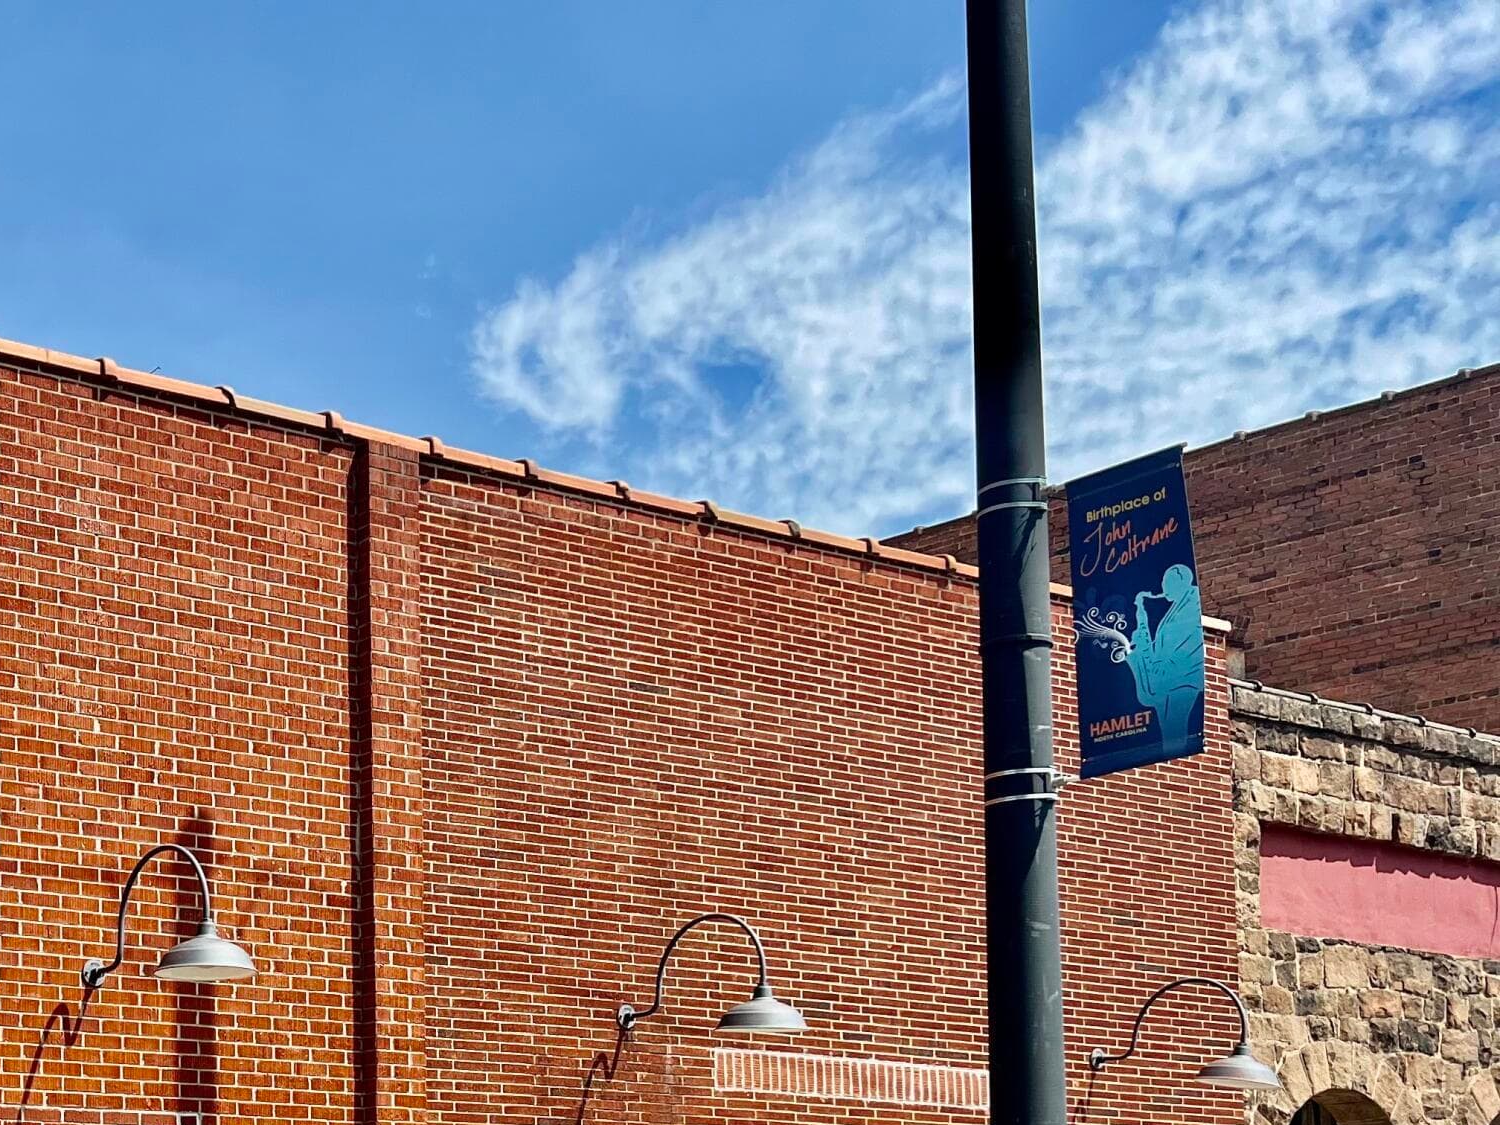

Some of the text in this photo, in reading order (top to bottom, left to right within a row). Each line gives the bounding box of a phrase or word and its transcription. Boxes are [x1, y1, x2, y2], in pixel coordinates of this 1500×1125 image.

[1086, 486, 1166, 523] Birthplace of
[1080, 519, 1131, 577] John
[1105, 517, 1179, 573] Coltrane
[1089, 710, 1152, 737] HAMLET
[1115, 727, 1148, 738] CAROLINA
